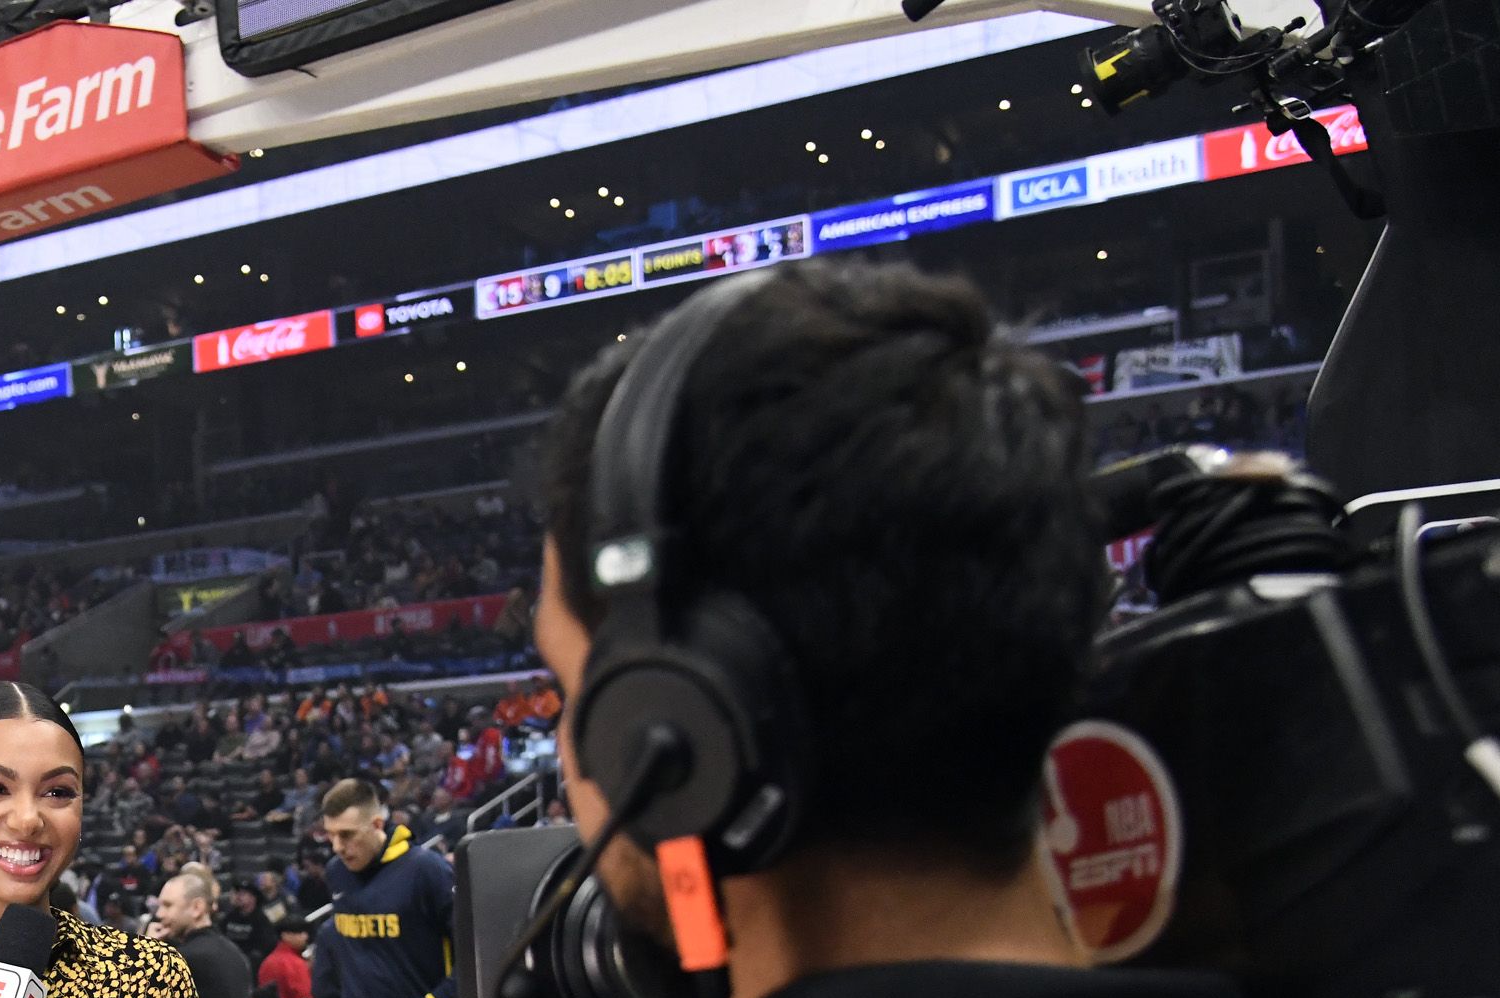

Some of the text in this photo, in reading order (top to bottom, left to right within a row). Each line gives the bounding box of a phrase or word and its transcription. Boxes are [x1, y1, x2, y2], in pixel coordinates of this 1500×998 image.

[1097, 154, 1189, 189] Health
[1018, 174, 1081, 204] UCLA
[818, 194, 988, 241] AMERICAN EXPRESS
[498, 283, 524, 307] 15
[544, 273, 562, 299] 9
[385, 298, 454, 325] TOYOTA
[1105, 792, 1157, 846] NBA
[1068, 842, 1160, 891] ESPN
